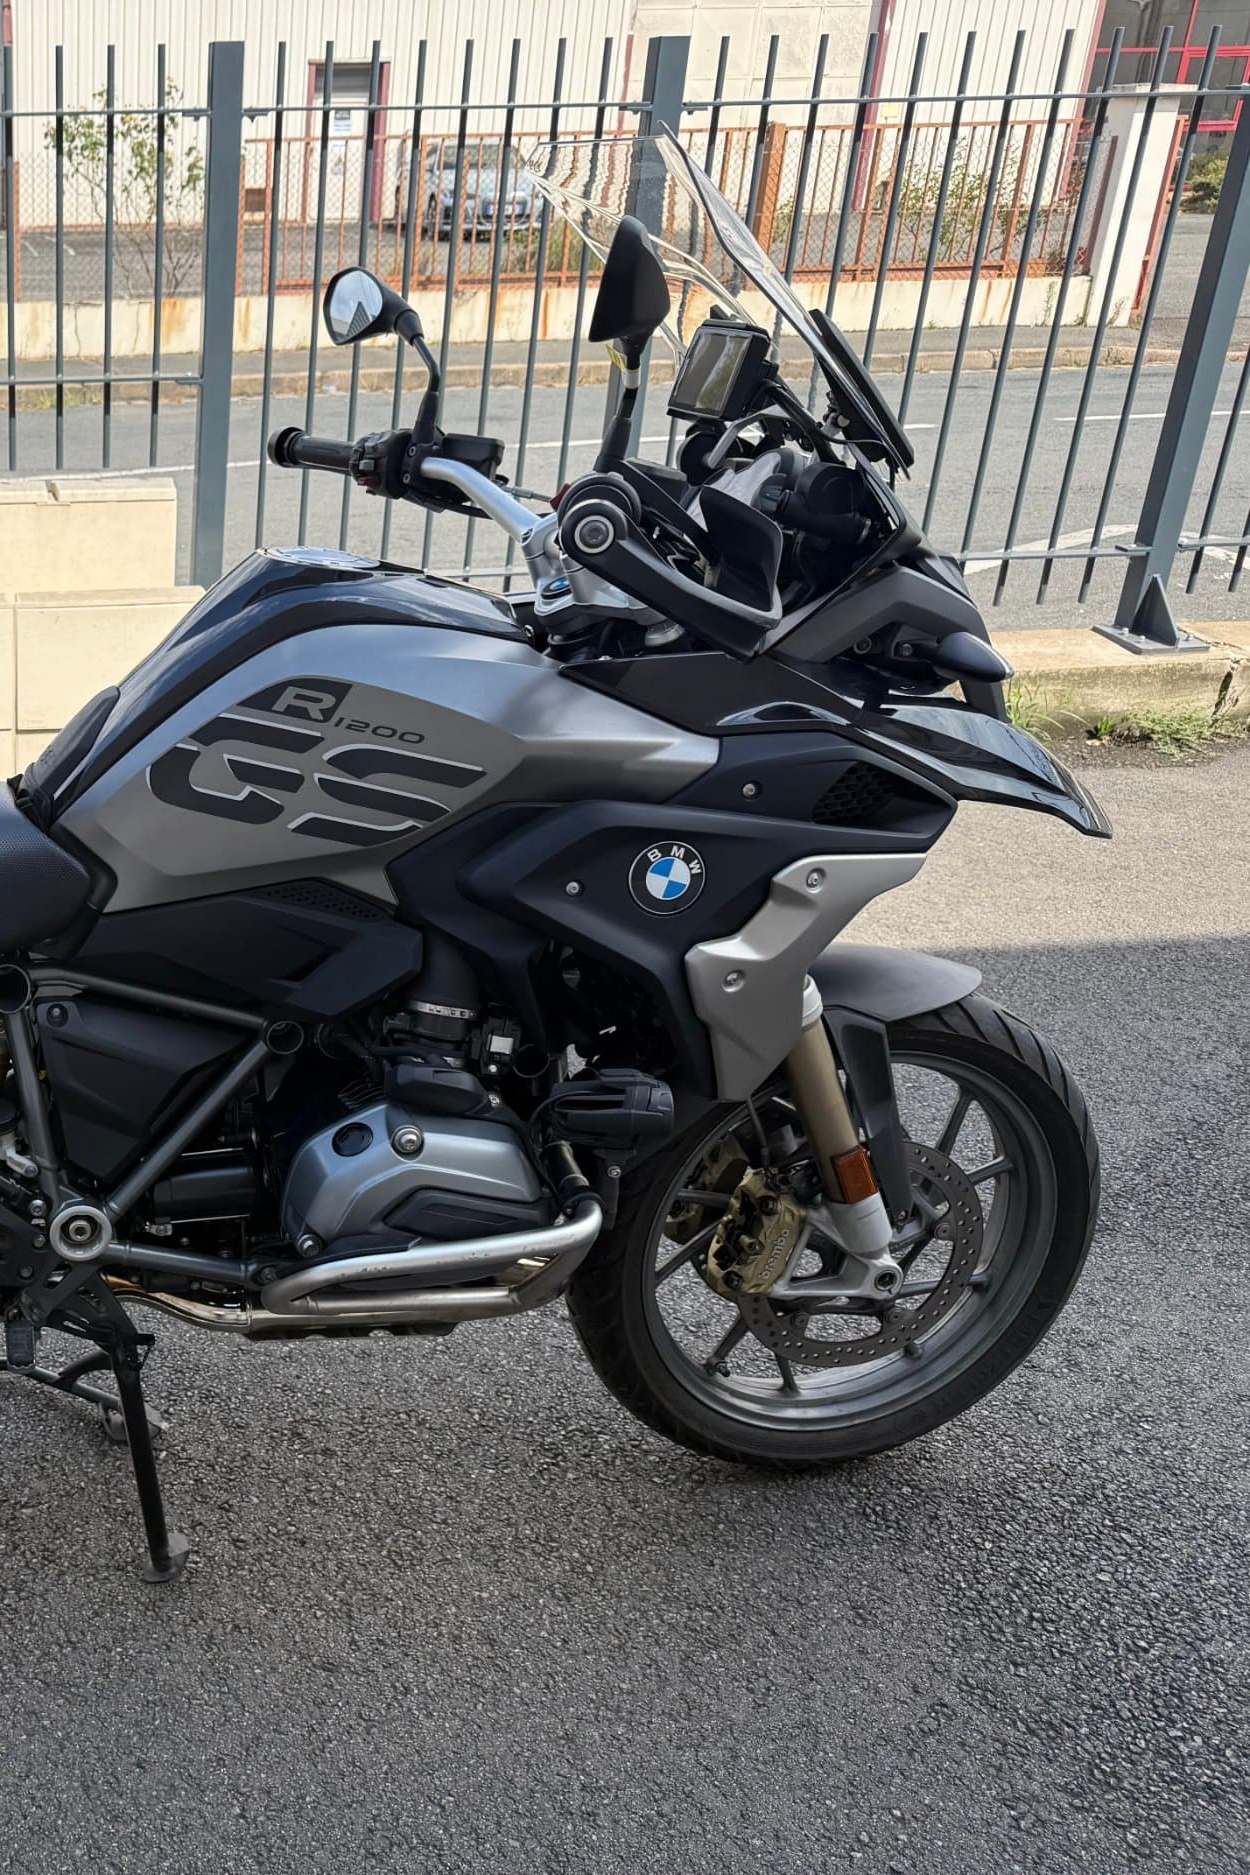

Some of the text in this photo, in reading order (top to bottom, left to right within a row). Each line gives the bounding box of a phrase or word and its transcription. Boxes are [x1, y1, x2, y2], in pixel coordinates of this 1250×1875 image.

[271, 686, 425, 744] R 1200
[145, 712, 487, 847] GS
[646, 845, 702, 875] BMW
[758, 1229, 789, 1279] brembo
